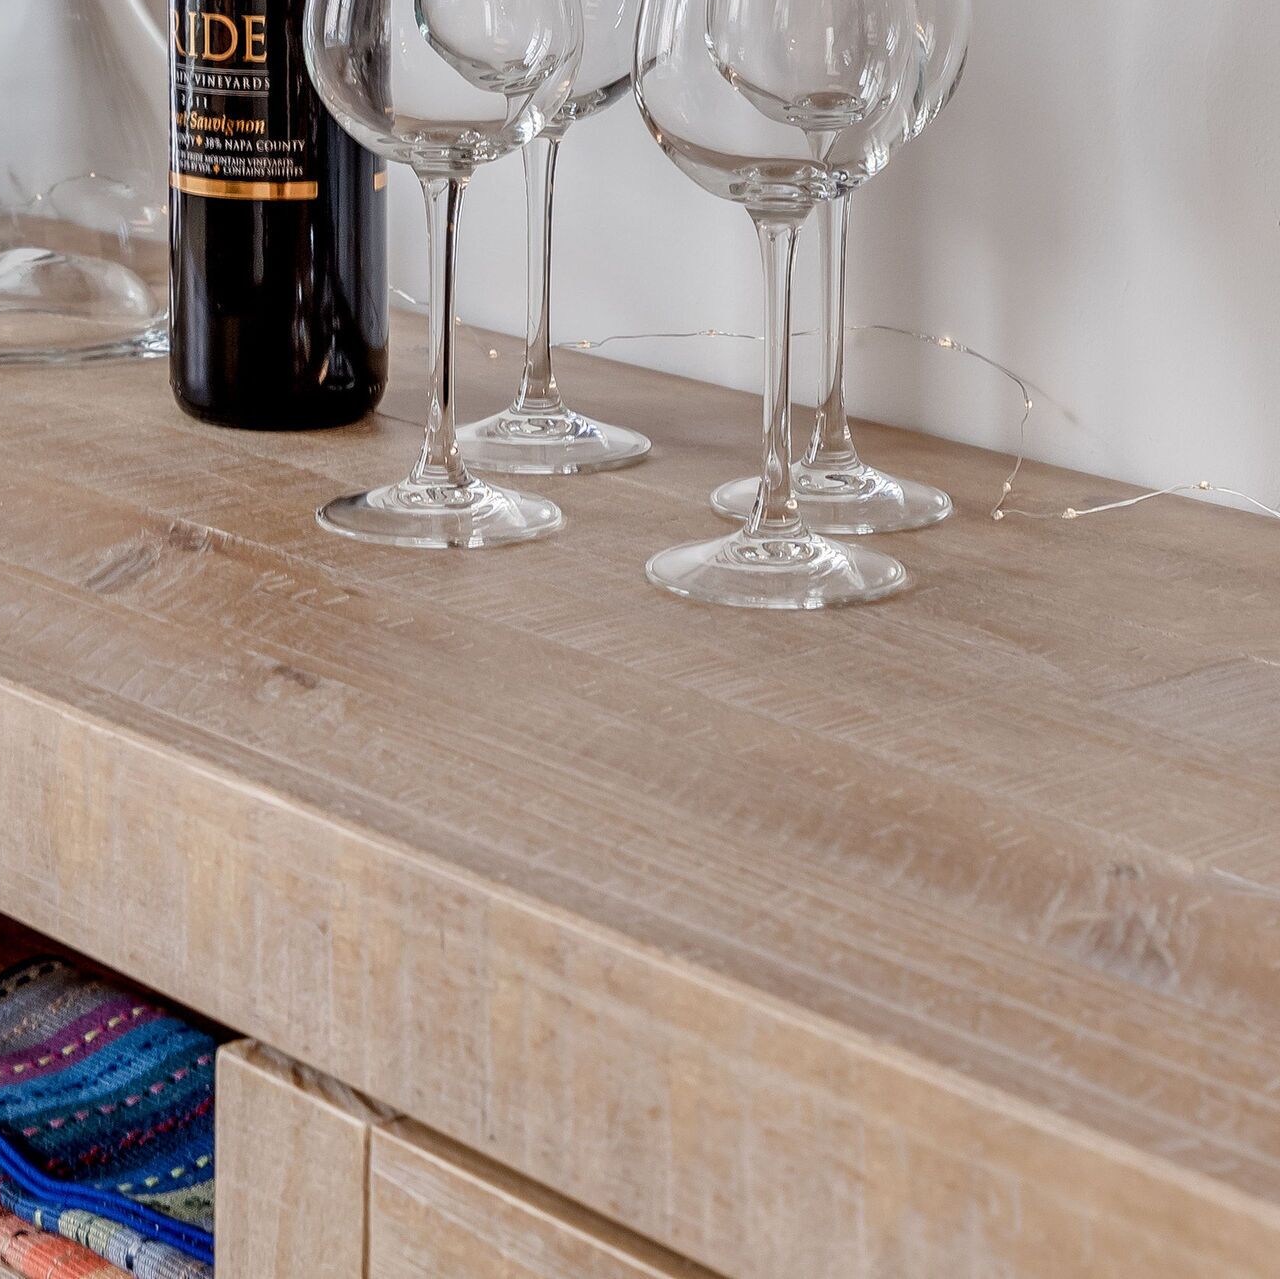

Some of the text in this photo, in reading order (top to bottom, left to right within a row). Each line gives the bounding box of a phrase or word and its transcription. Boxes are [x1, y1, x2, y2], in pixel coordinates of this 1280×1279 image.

[194, 73, 270, 91] VINEYARDS
[190, 111, 266, 137] Sauvignon
[224, 138, 253, 152] NAPA
[256, 138, 306, 153] COUNTY
